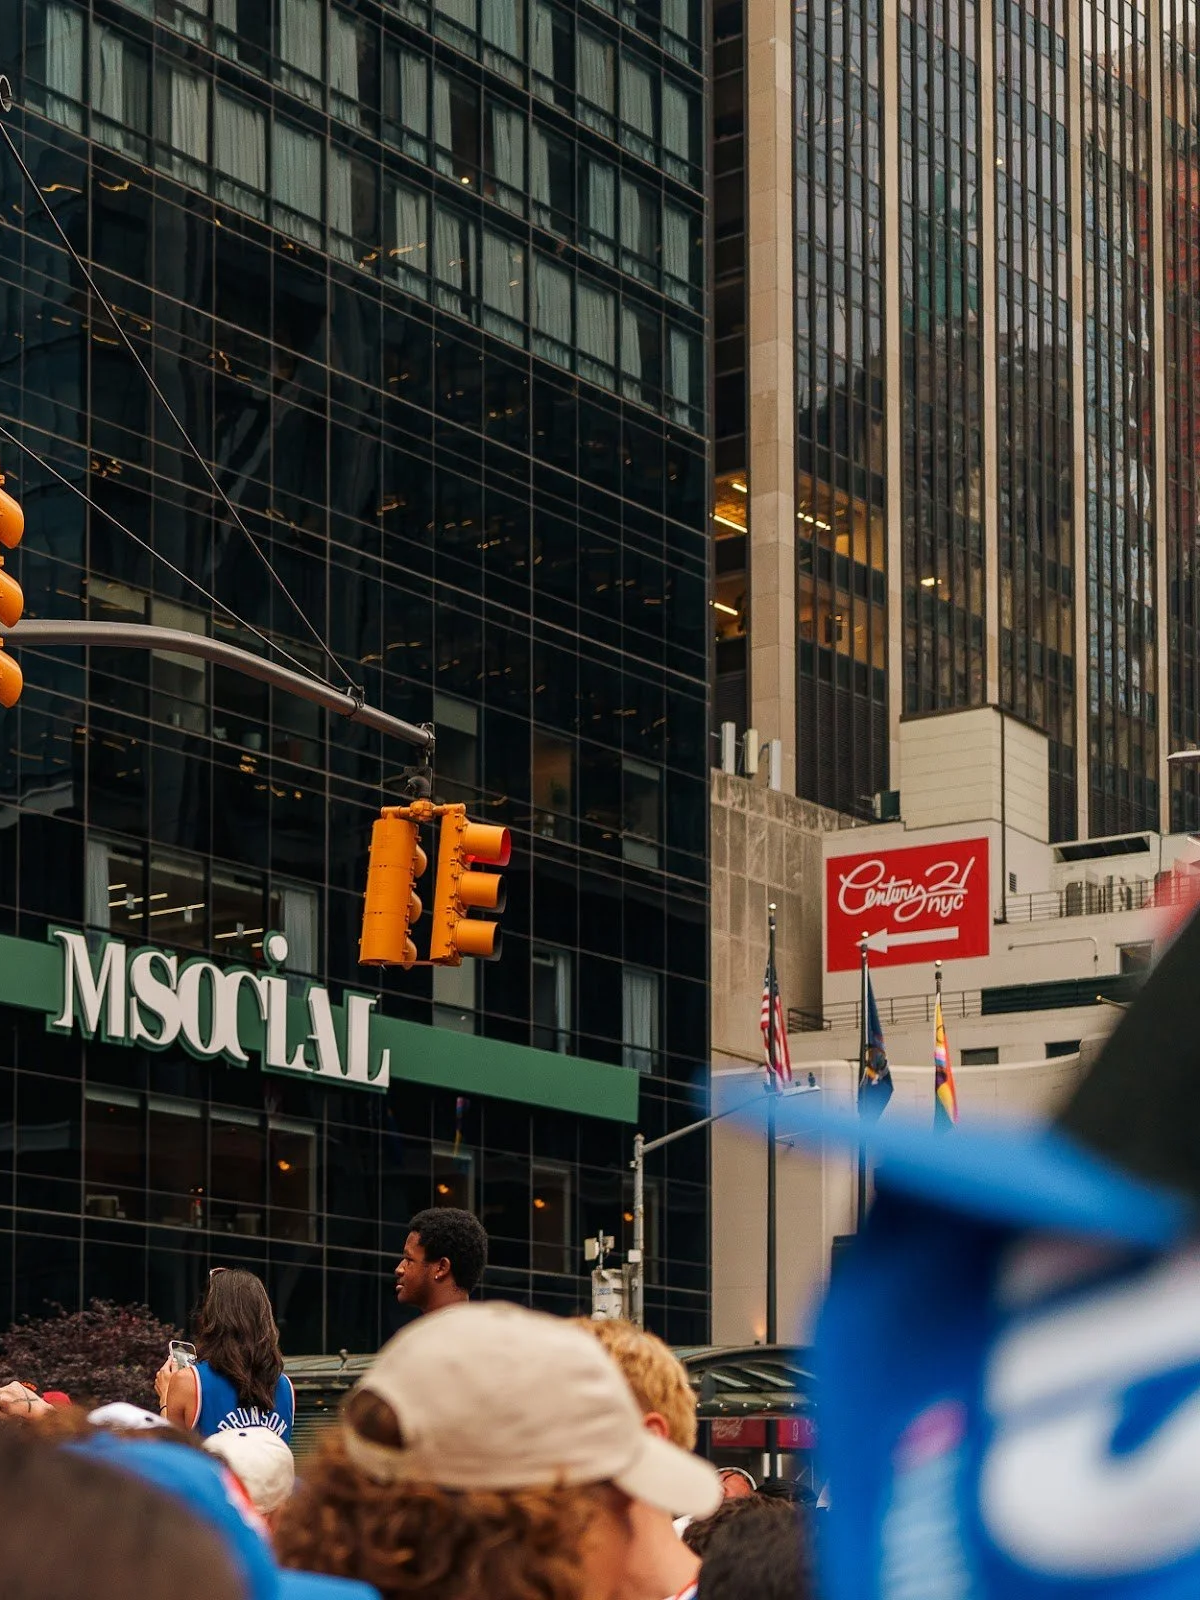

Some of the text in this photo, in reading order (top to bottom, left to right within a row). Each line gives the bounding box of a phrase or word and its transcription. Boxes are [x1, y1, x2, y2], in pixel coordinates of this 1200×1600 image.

[838, 856, 976, 922] Century 21
[927, 894, 964, 918] nyc
